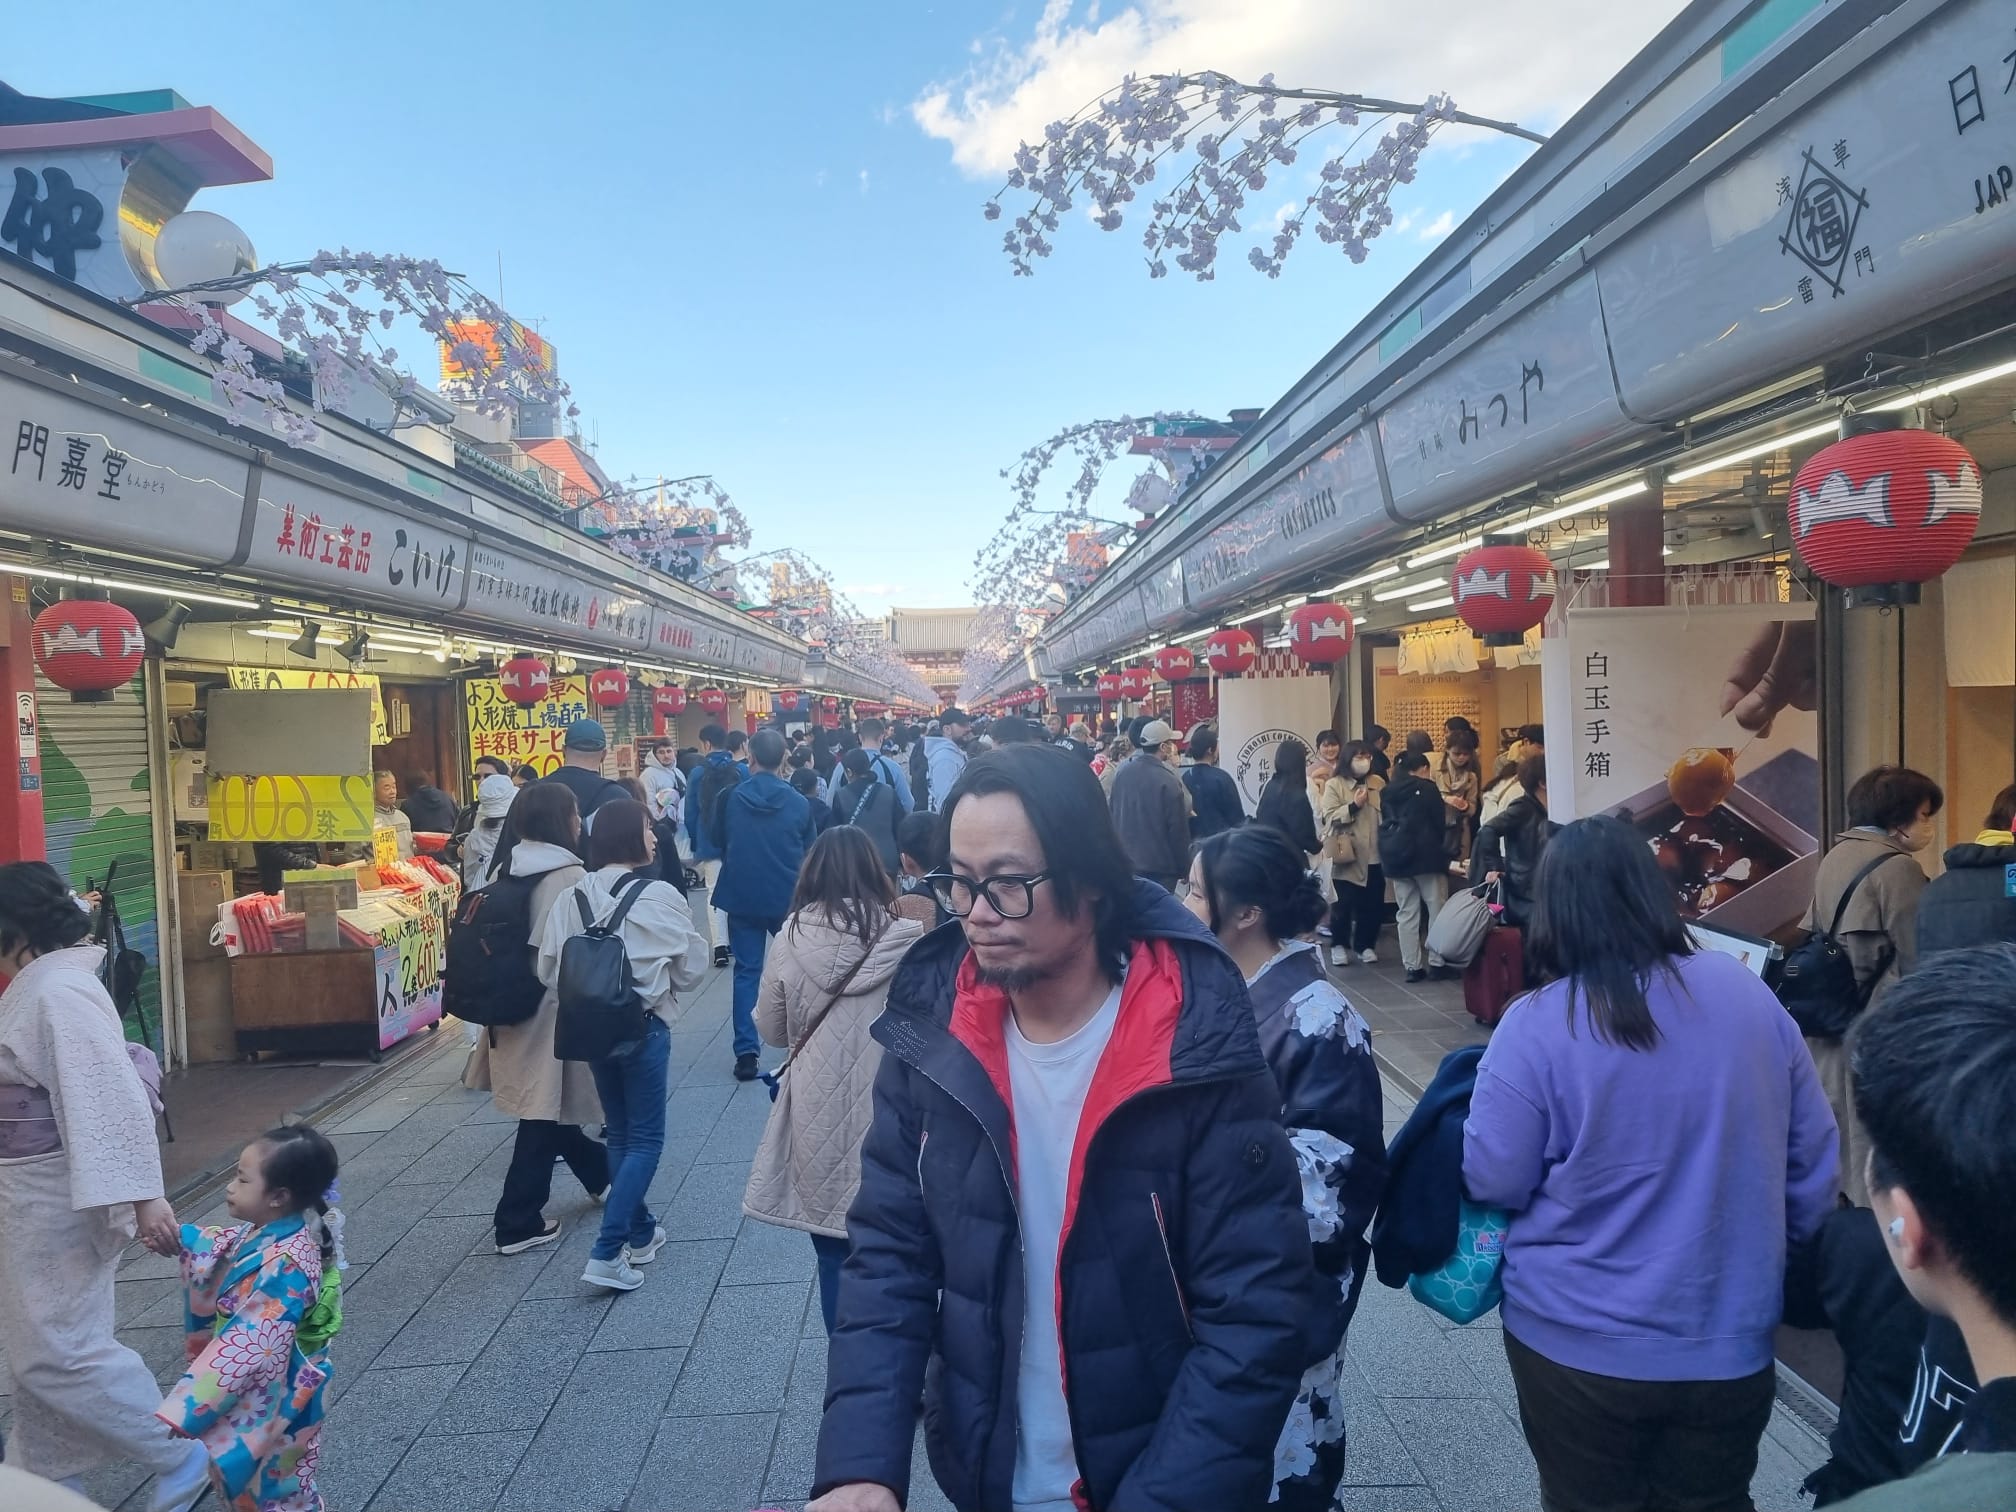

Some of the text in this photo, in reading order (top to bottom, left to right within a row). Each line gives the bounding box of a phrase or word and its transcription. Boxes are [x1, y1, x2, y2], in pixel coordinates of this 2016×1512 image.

[1801, 186, 1846, 259] 福
[1459, 359, 1544, 445] みつや
[1279, 486, 1337, 541] COSMETICS
[388, 528, 457, 598] こいけ
[474, 729, 567, 757] 半額サービ
[1584, 651, 1612, 779] 白玉手箱
